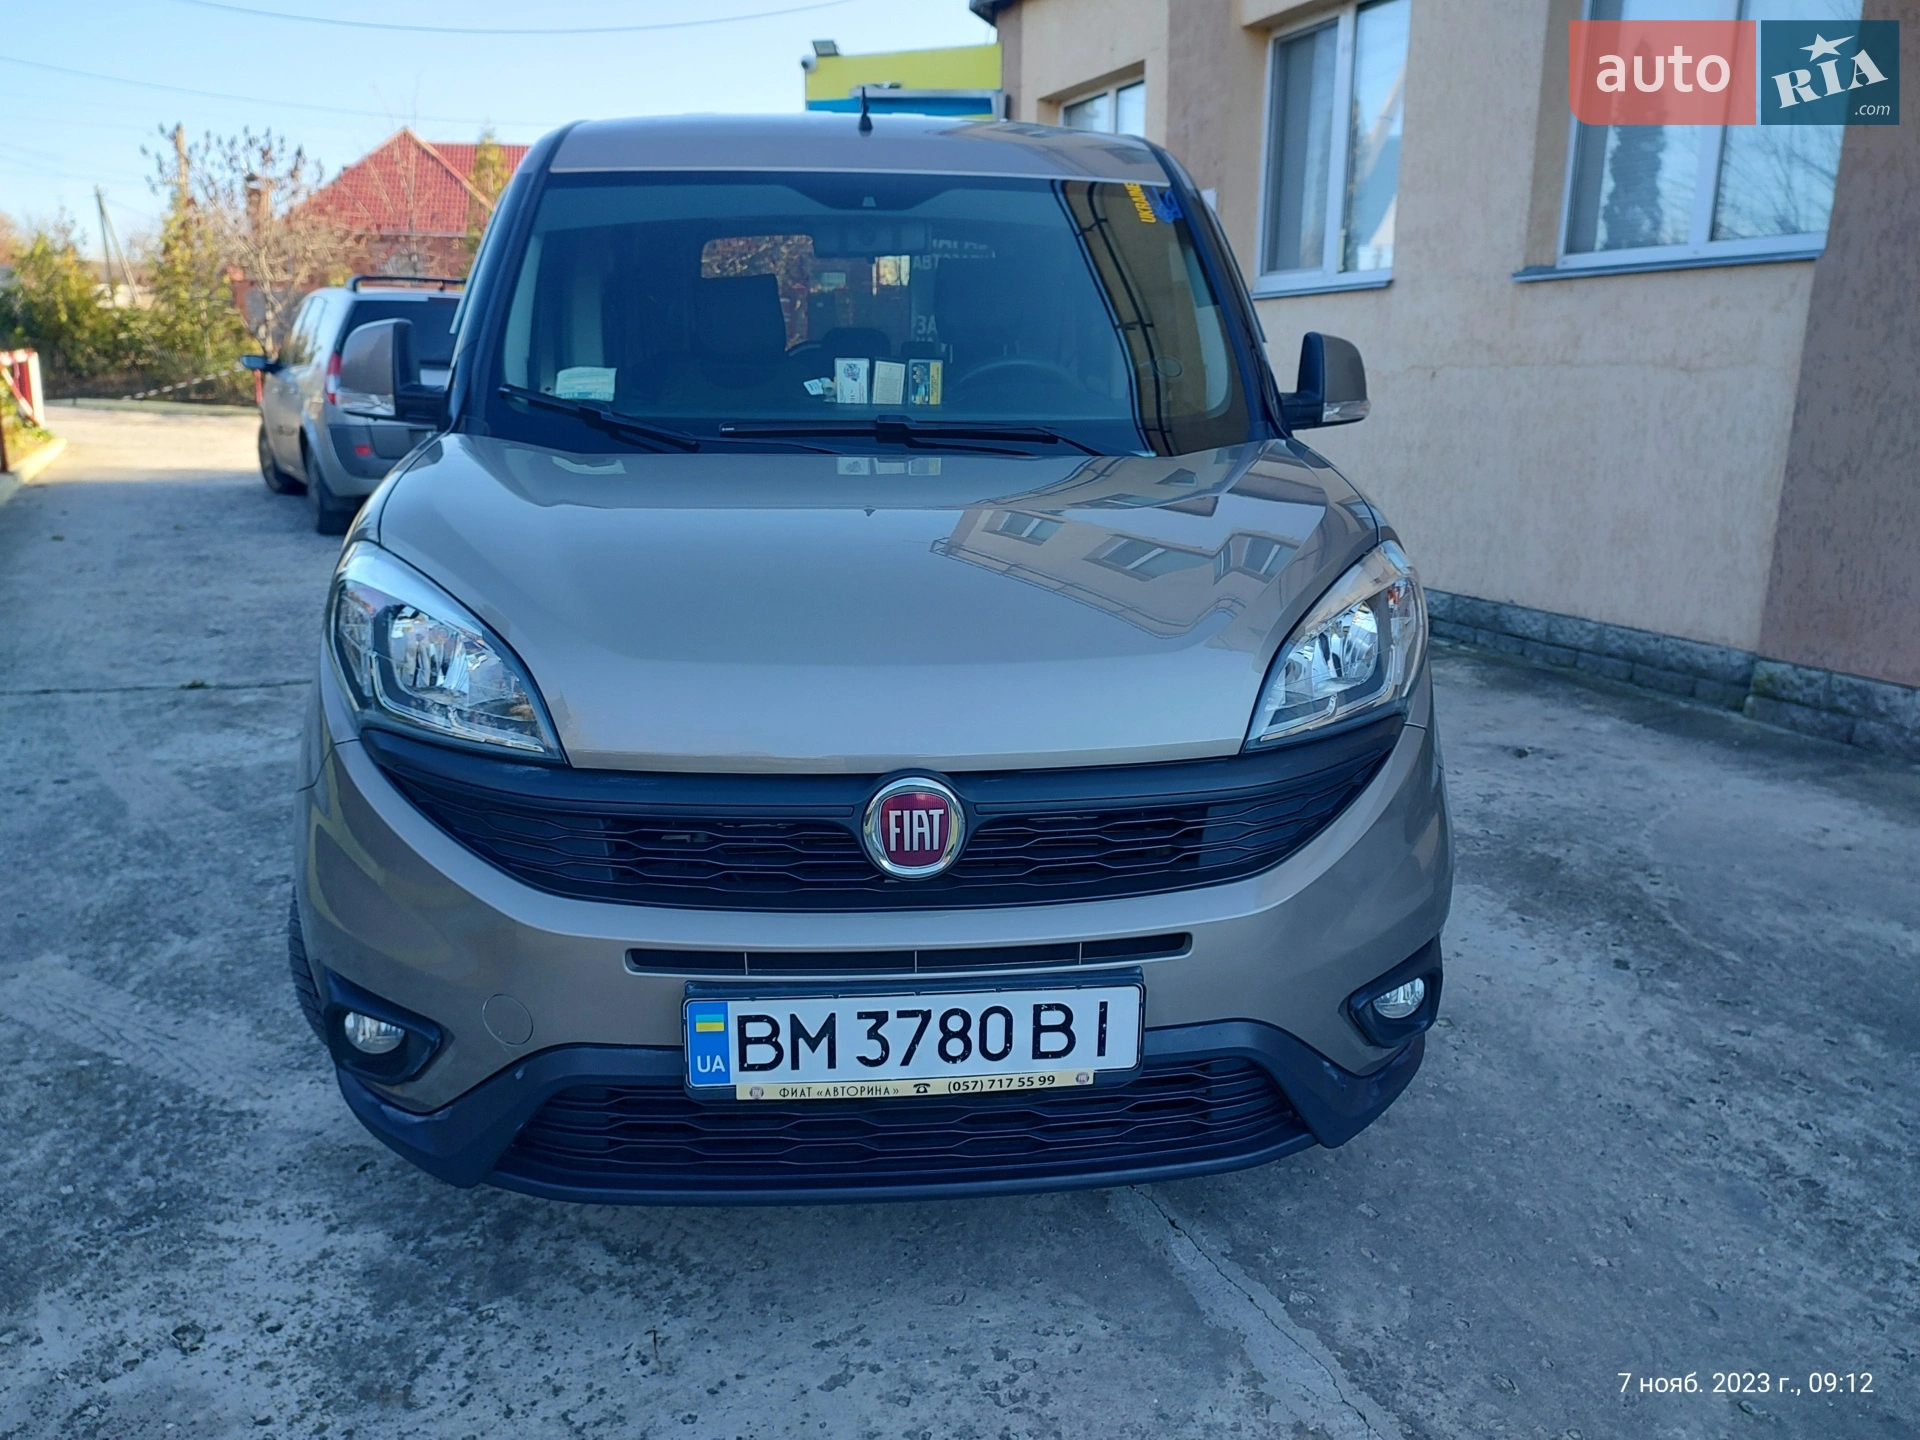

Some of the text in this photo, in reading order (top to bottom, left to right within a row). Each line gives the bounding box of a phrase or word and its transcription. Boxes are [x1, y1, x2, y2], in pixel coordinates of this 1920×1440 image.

[889, 809, 944, 851] FIAT
[856, 1005, 1013, 1068] 3780
[697, 1056, 726, 1073] UA
[779, 1085, 899, 1098] ФИАТ «АВТОРИНА»
[947, 1075, 1056, 1094] (057) 717 55 99
